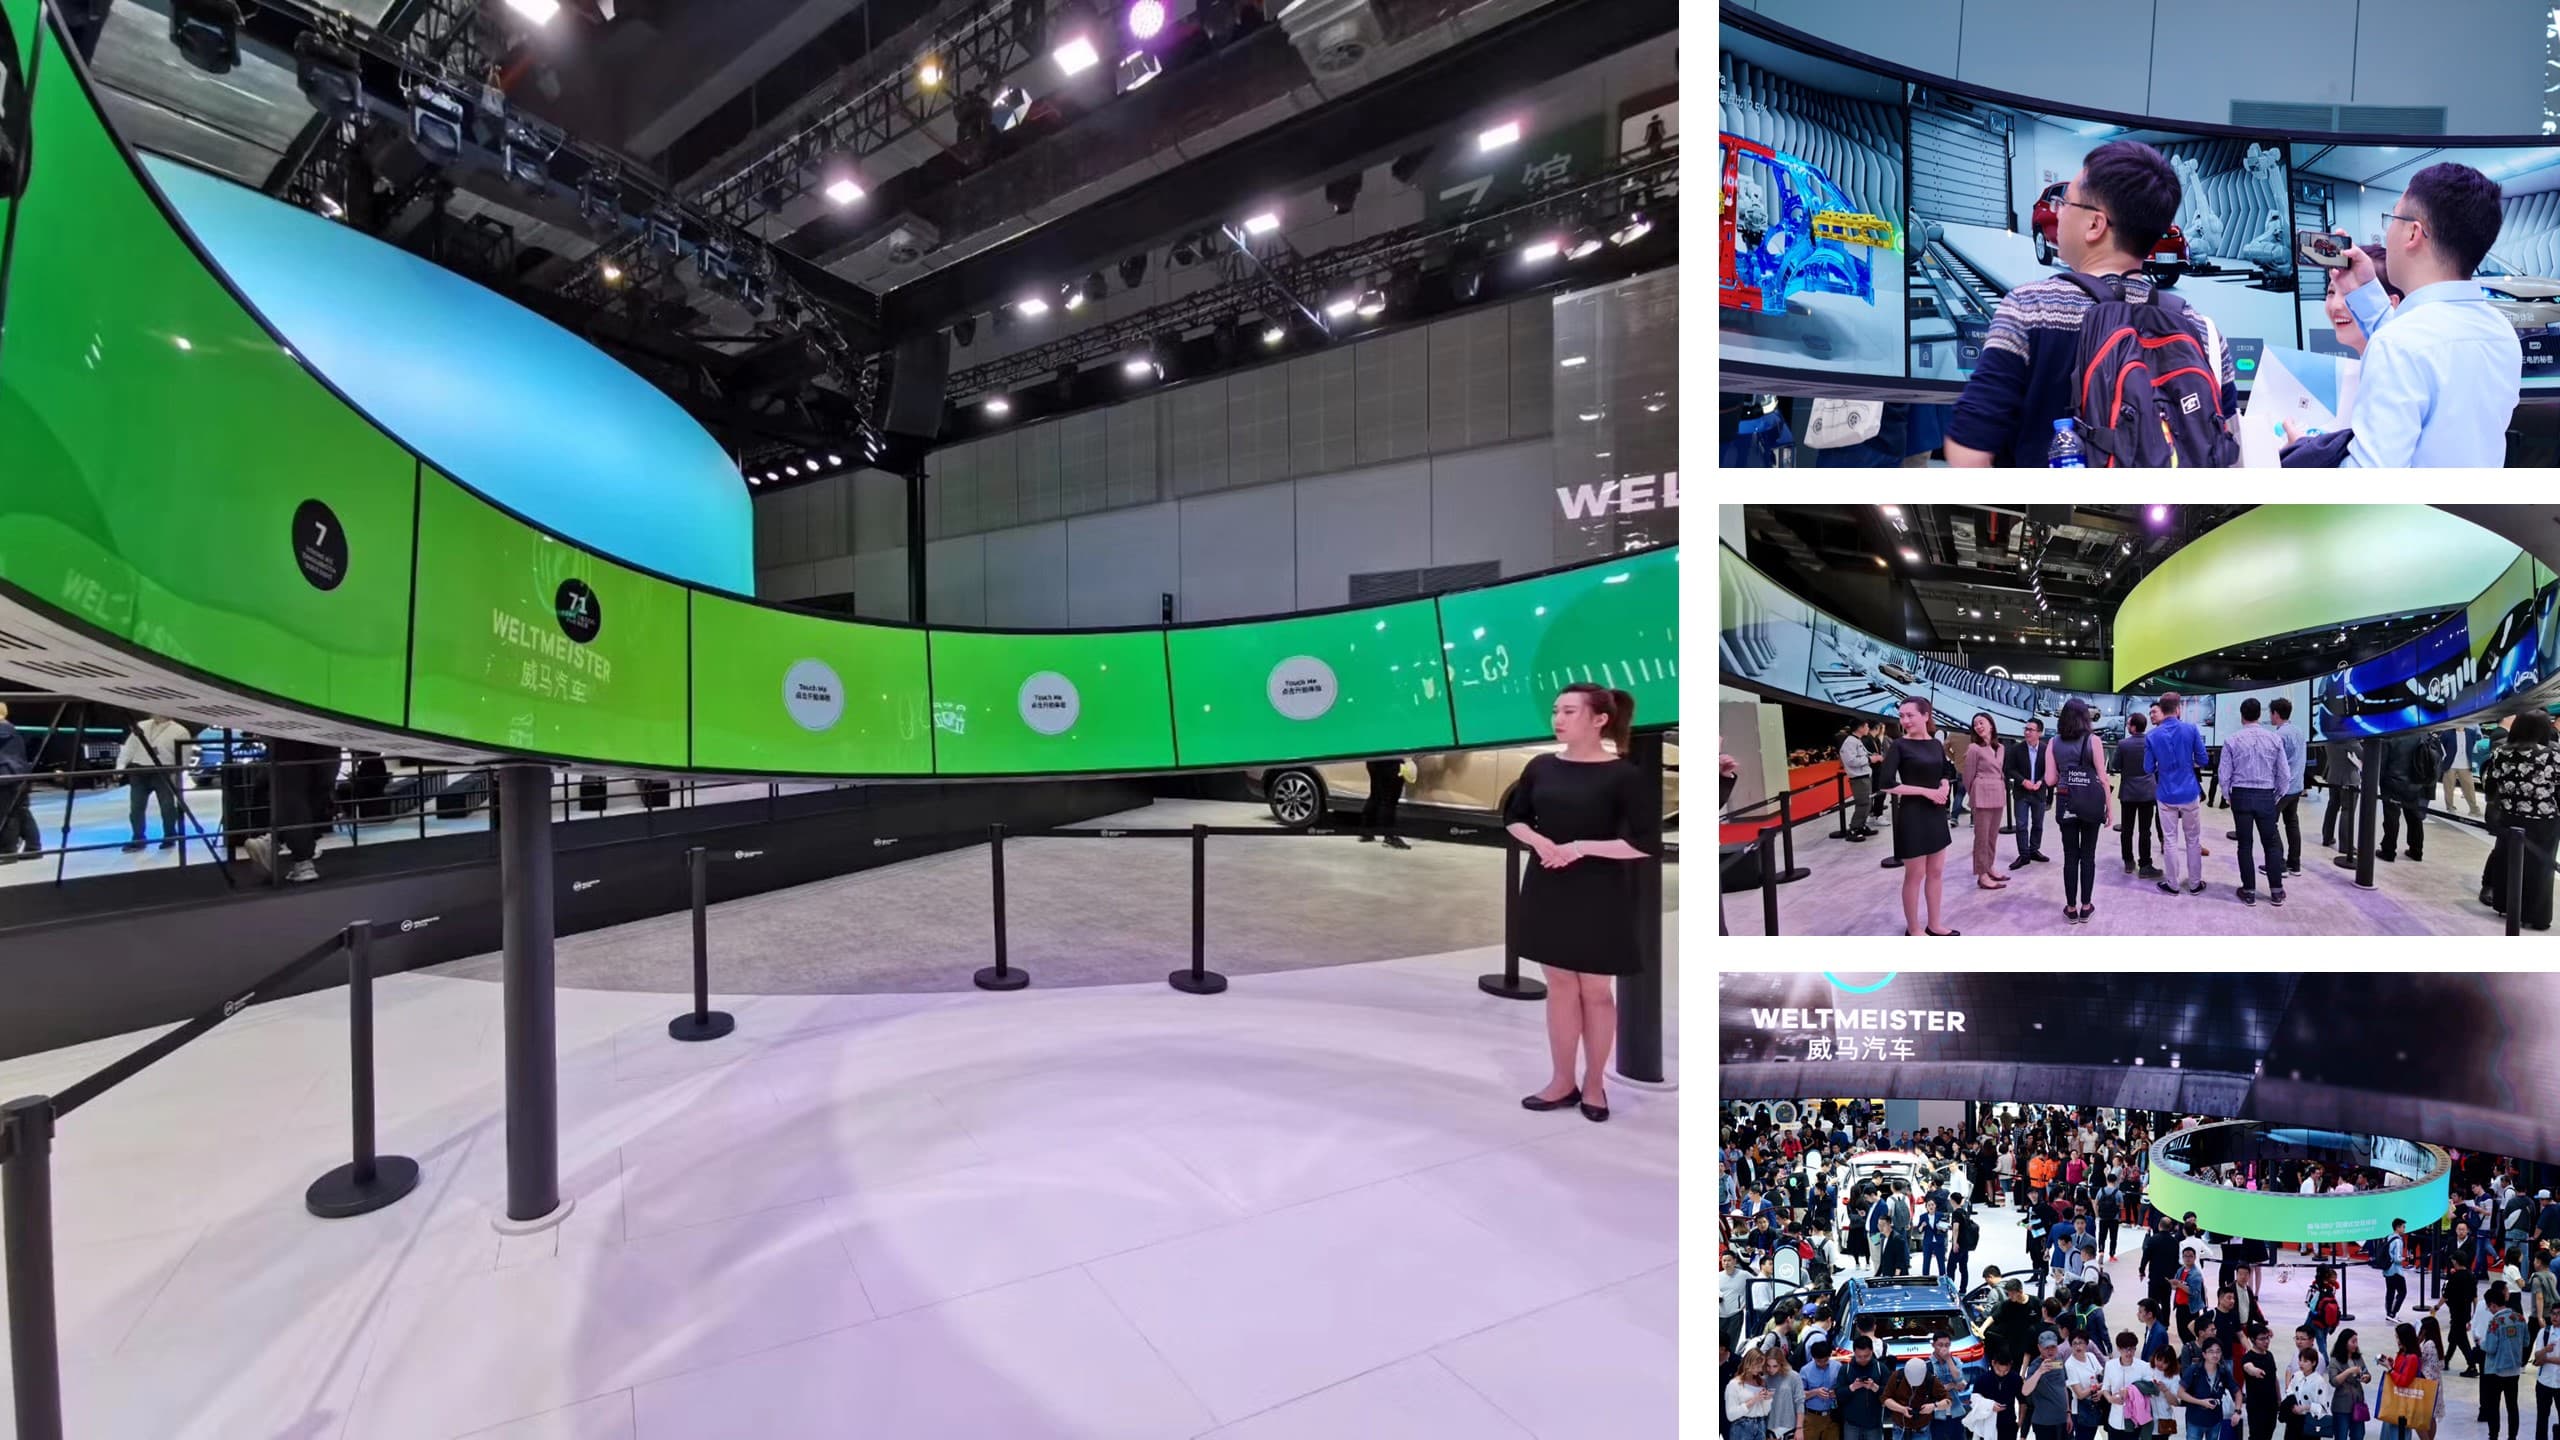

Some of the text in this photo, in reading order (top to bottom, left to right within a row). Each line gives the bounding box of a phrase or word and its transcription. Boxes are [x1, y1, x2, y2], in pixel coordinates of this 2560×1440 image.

[315, 520, 328, 547] 7
[568, 591, 588, 616] 71
[492, 607, 612, 683] WELTMEISTER
[520, 658, 588, 703] 威马汽车
[2068, 776, 2091, 784] Futures
[1750, 1007, 1966, 1032] WELTMEISTER
[1806, 1036, 1916, 1062] 威马汽车
